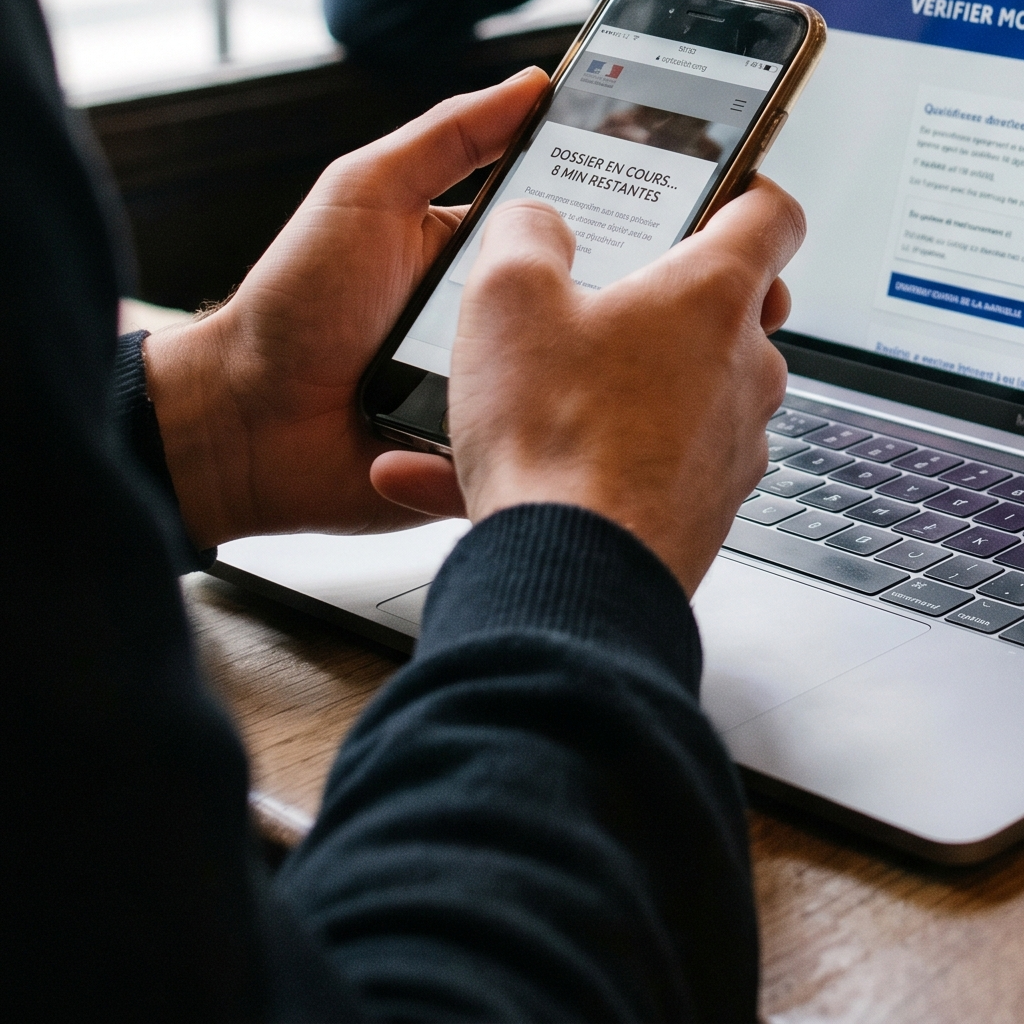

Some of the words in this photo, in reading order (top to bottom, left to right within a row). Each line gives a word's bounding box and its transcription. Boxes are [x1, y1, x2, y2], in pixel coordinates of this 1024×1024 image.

[550, 147, 605, 170] DOSSIER
[605, 161, 625, 175] EN
[626, 166, 678, 190] COURS...
[551, 165, 561, 176] 8
[561, 167, 588, 183] MIN
[588, 175, 661, 202] RESTANTES
